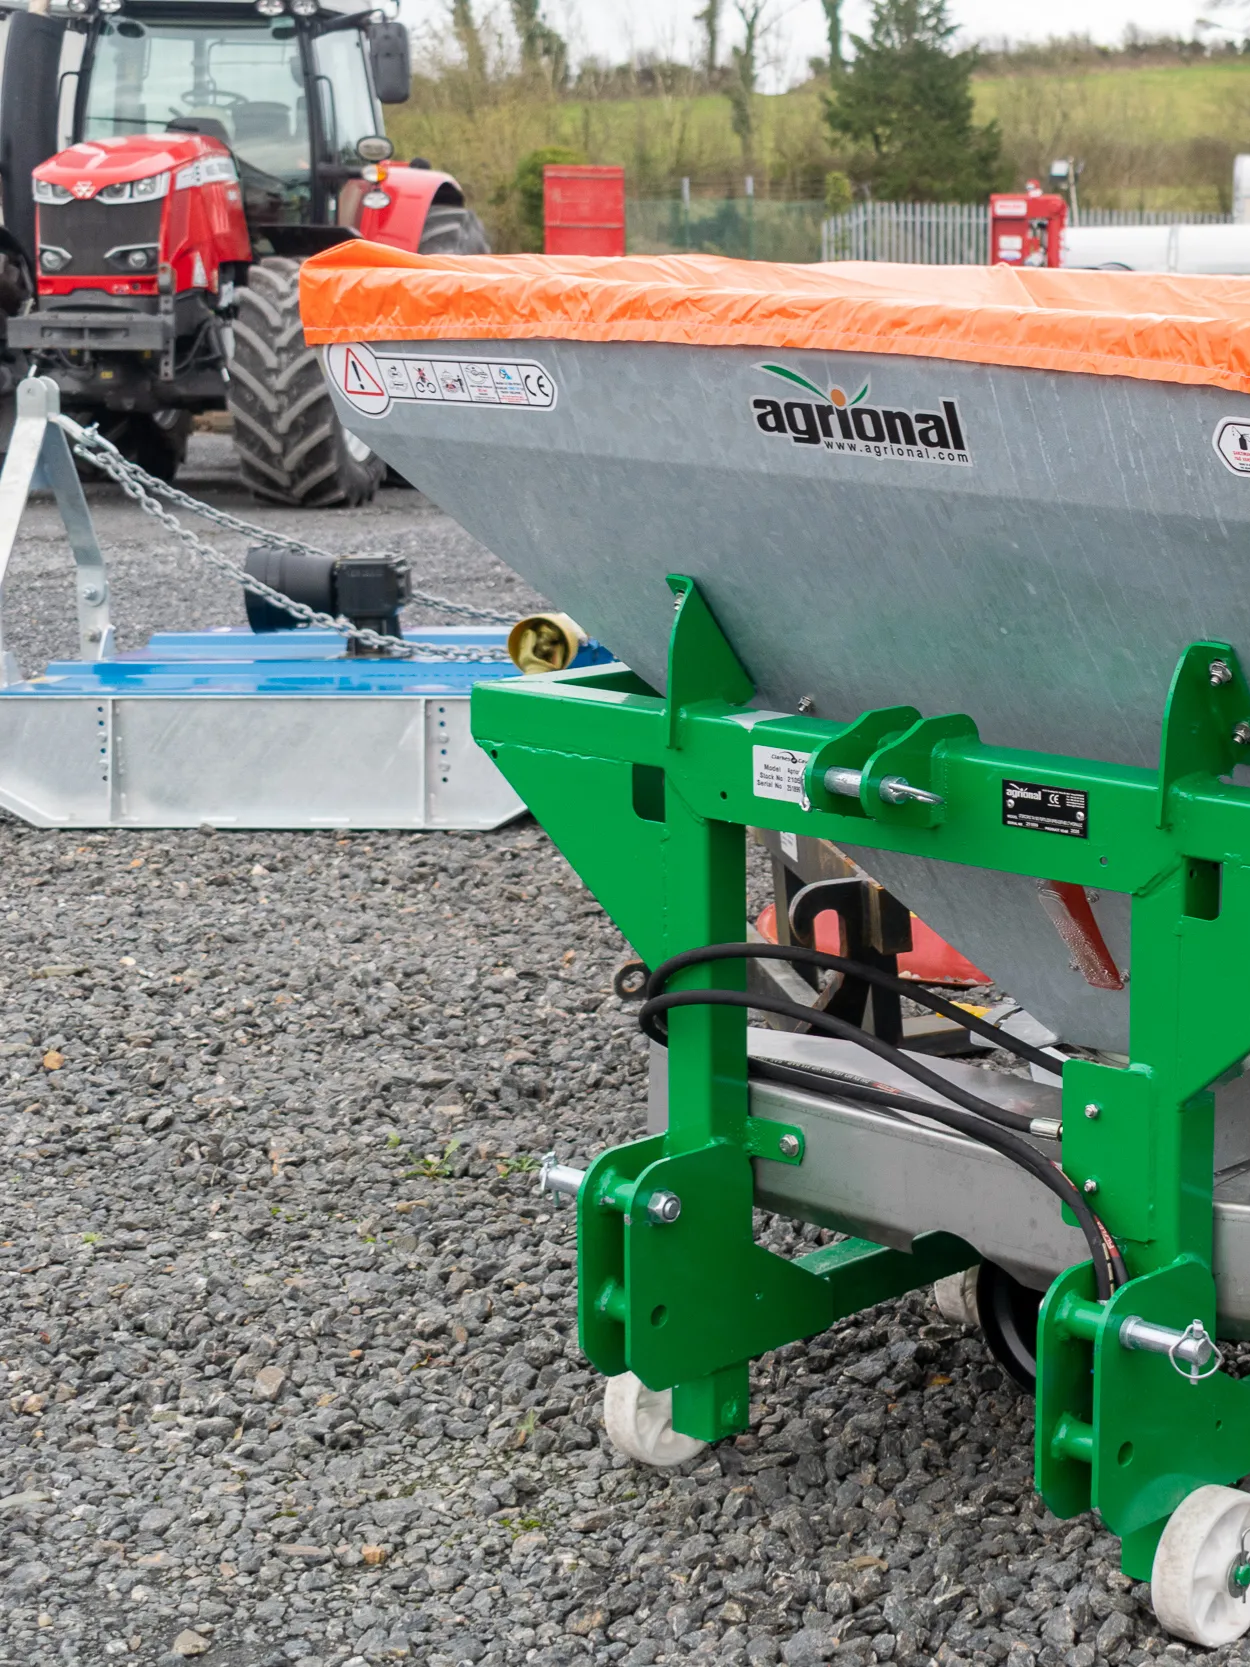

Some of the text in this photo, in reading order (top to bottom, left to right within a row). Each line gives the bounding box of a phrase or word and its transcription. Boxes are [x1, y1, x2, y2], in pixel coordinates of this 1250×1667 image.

[753, 399, 967, 451] agrional
[823, 440, 969, 463] www.agrional.com
[764, 764, 781, 773] Model
[760, 772, 774, 780] Stock
[757, 780, 773, 788] Serial
[1006, 789, 1042, 801] agrional
[1049, 794, 1060, 804] CE
